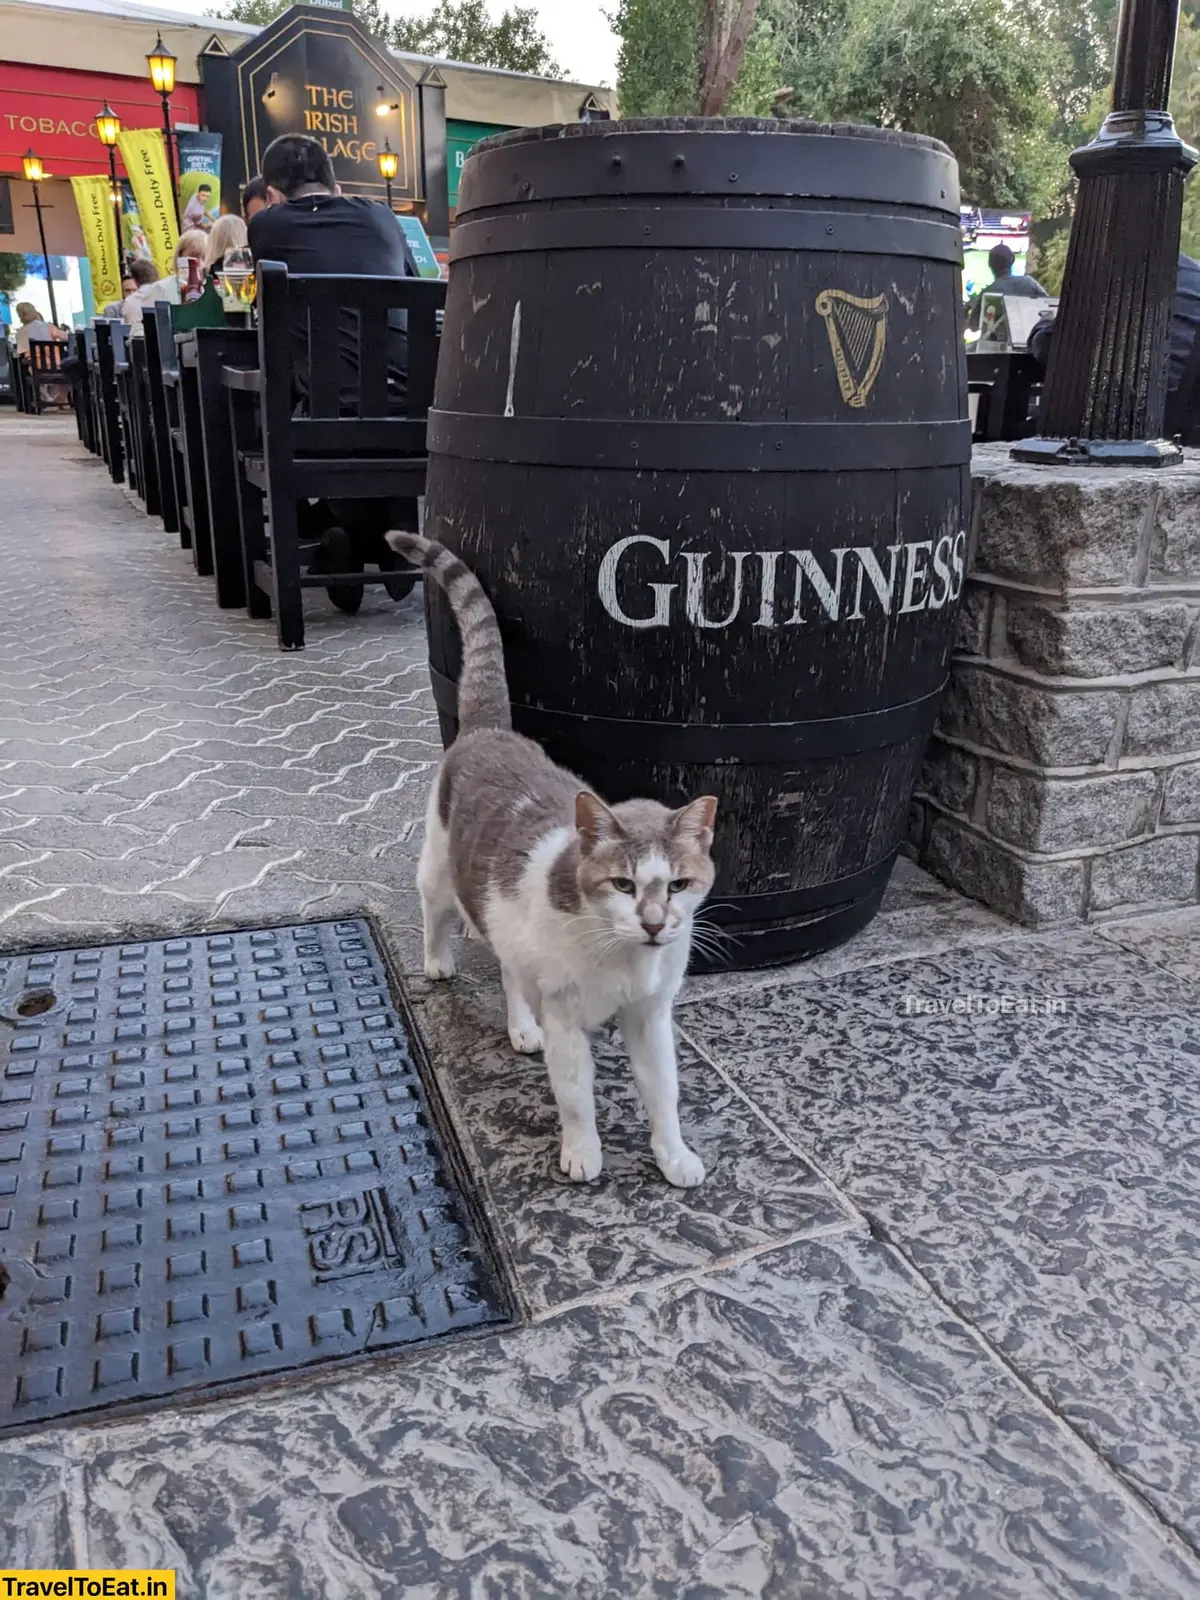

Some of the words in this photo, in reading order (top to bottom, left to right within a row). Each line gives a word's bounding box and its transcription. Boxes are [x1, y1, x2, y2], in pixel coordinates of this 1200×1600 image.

[304, 84, 353, 110] THE
[4, 114, 99, 138] TOBACC
[304, 109, 358, 135] IRISH
[140, 149, 154, 176] Free
[320, 136, 377, 165] LAGE
[90, 193, 100, 216] Free
[150, 179, 165, 209] Duty
[95, 218, 104, 243] Duty
[160, 212, 173, 250] Dubai
[598, 530, 966, 629] GUINNESS
